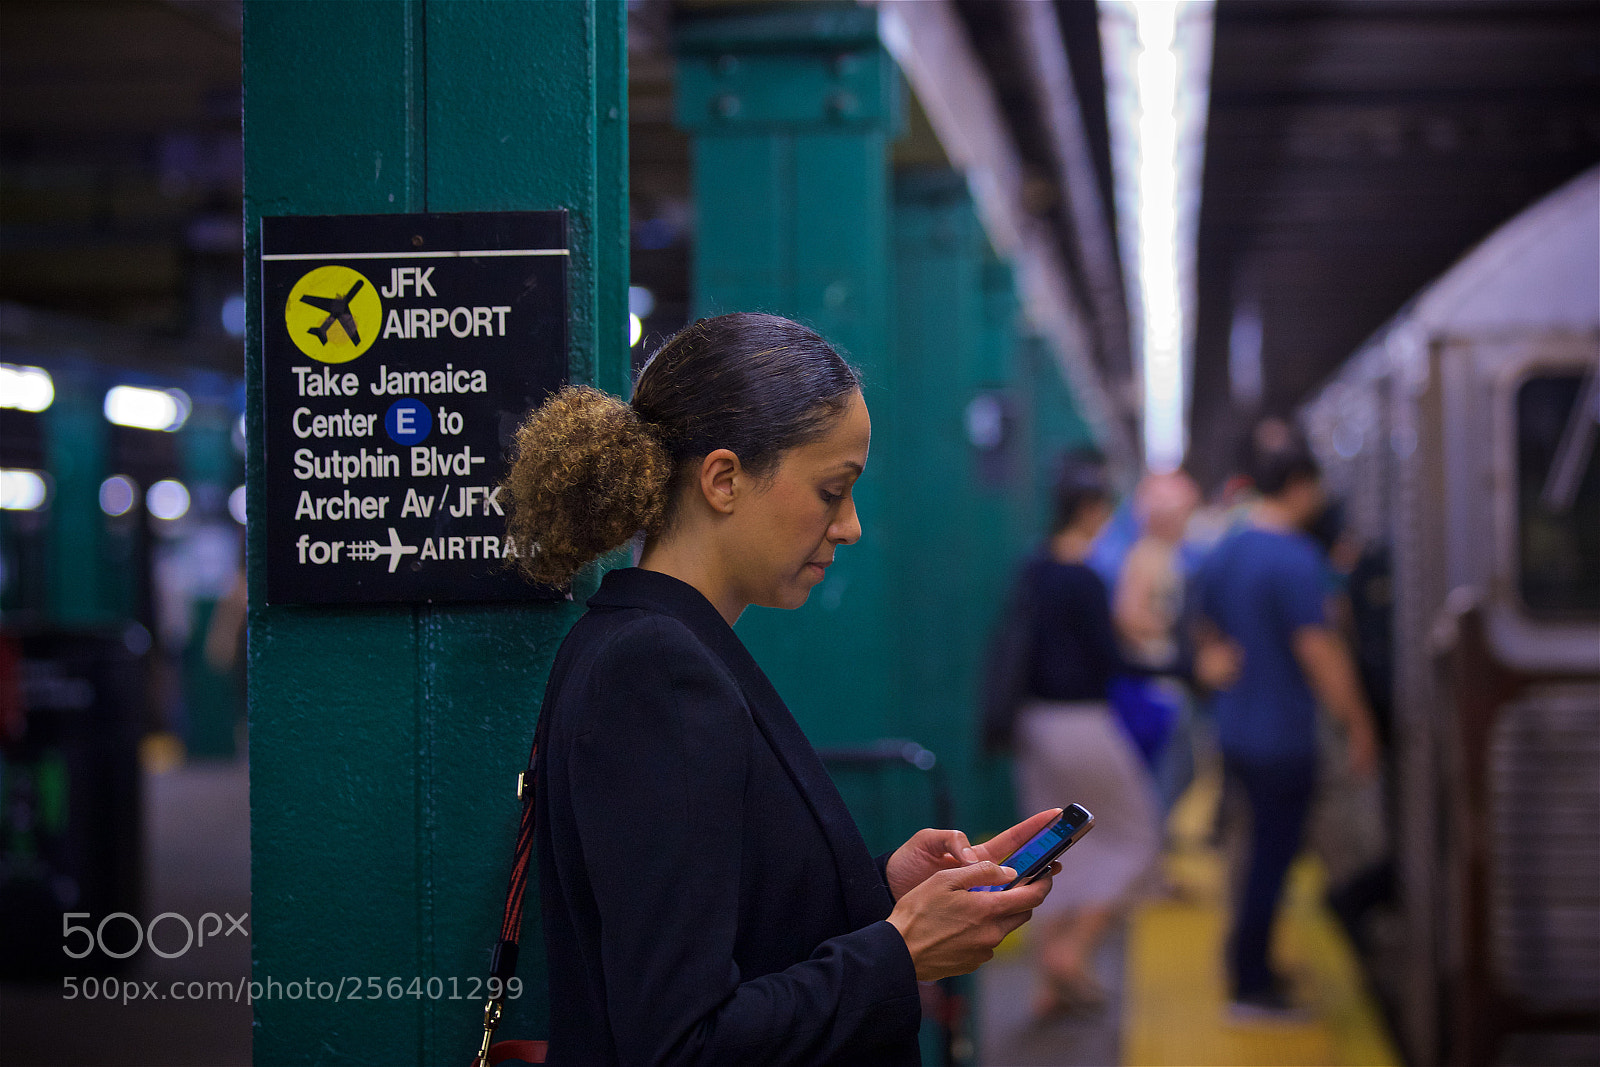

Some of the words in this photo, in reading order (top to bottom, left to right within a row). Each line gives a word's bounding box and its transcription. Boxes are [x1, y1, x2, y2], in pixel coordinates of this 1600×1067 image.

[381, 266, 437, 299] JFK
[382, 305, 511, 339] AIRPORT
[291, 365, 359, 397] Take
[370, 363, 487, 396] Jamaica
[292, 406, 377, 438] Center
[396, 408, 416, 434] E
[438, 406, 464, 435] to
[293, 447, 400, 484] Sutphin
[410, 445, 485, 477] Blvd-
[294, 490, 389, 520] Archer
[296, 534, 344, 564] for
[420, 535, 541, 560] AIRTRA
